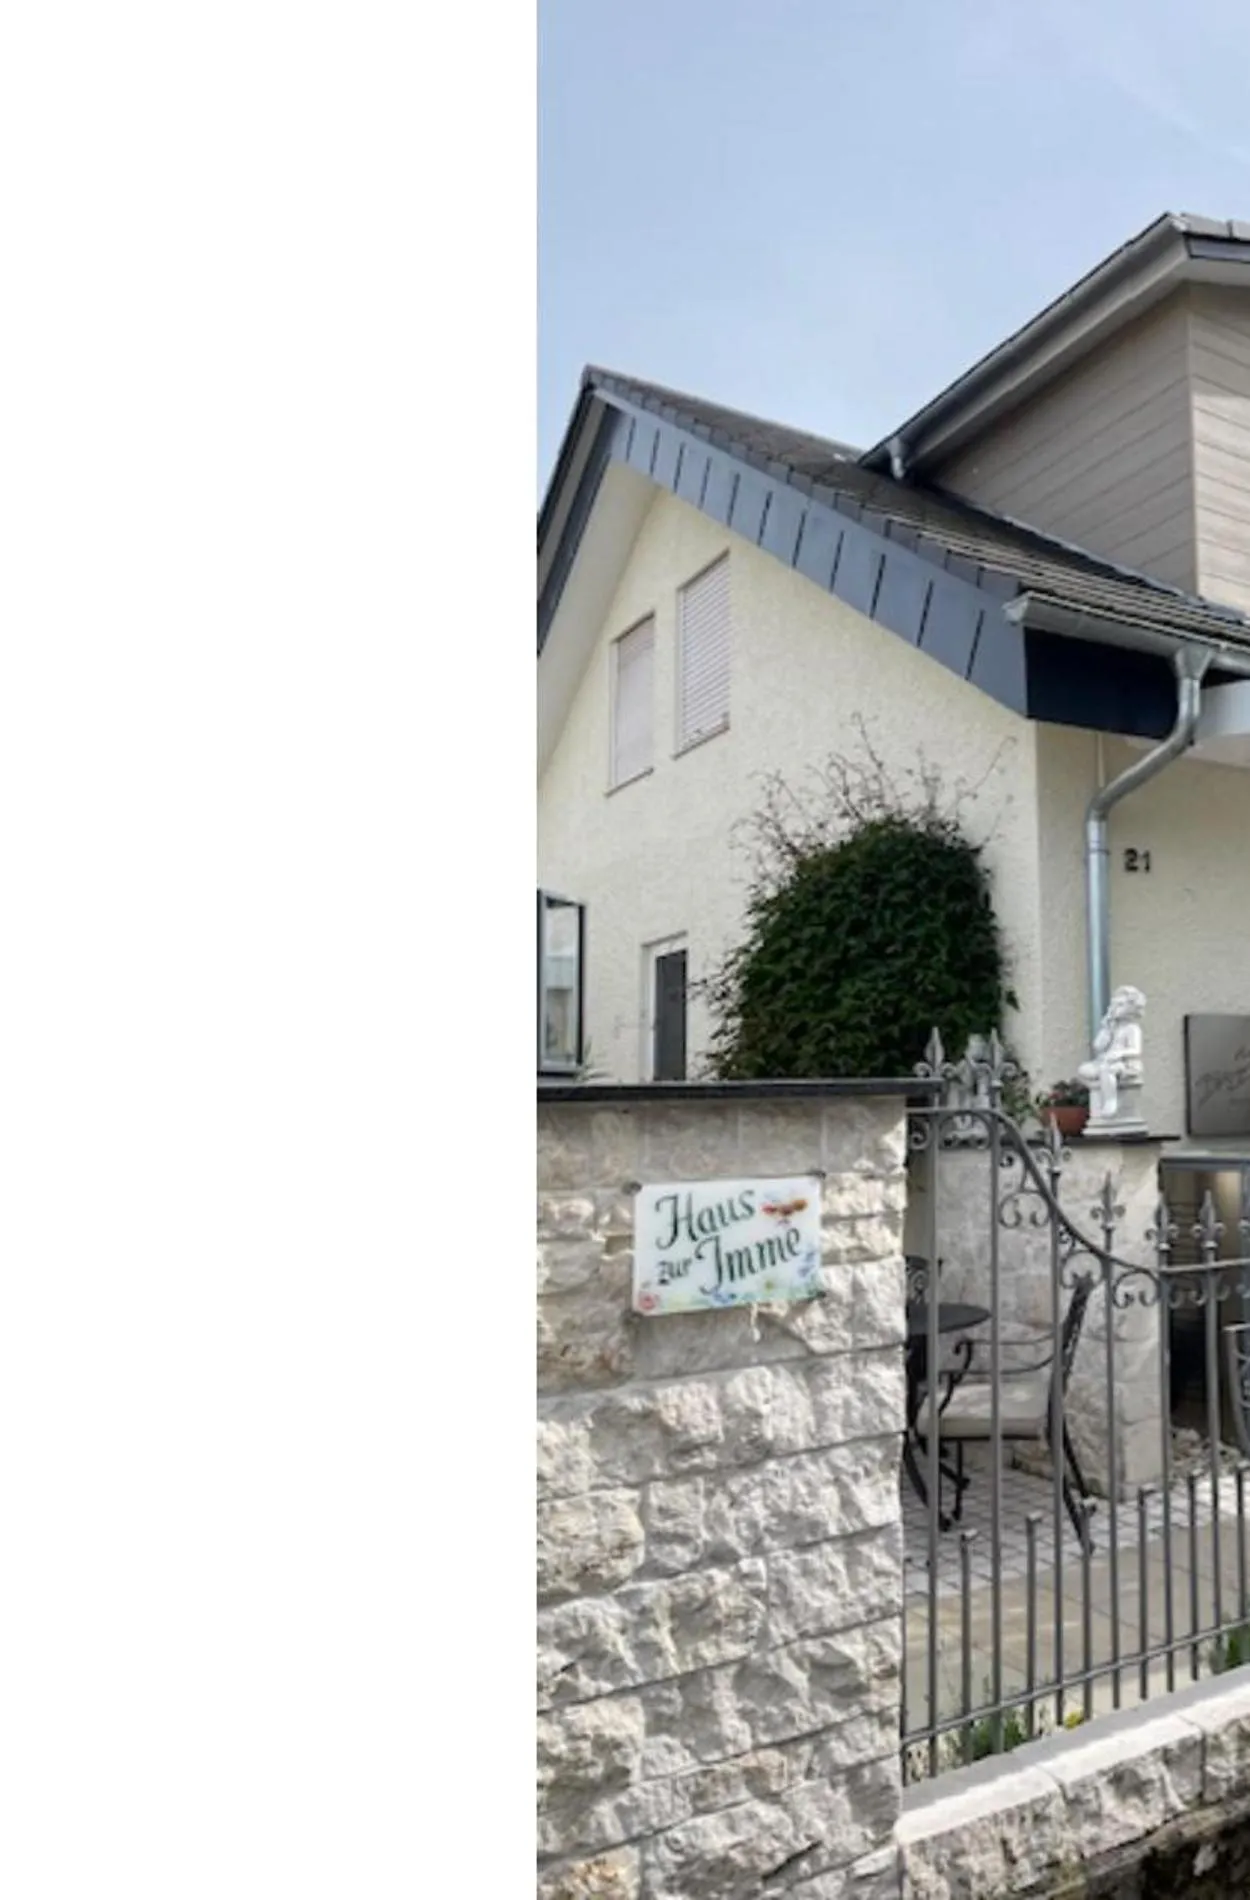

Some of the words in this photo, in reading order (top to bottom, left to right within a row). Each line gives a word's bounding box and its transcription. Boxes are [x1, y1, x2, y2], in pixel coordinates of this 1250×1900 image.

[1124, 848, 1151, 873] 21
[655, 1190, 756, 1250] Haus
[657, 1257, 692, 1285] zur
